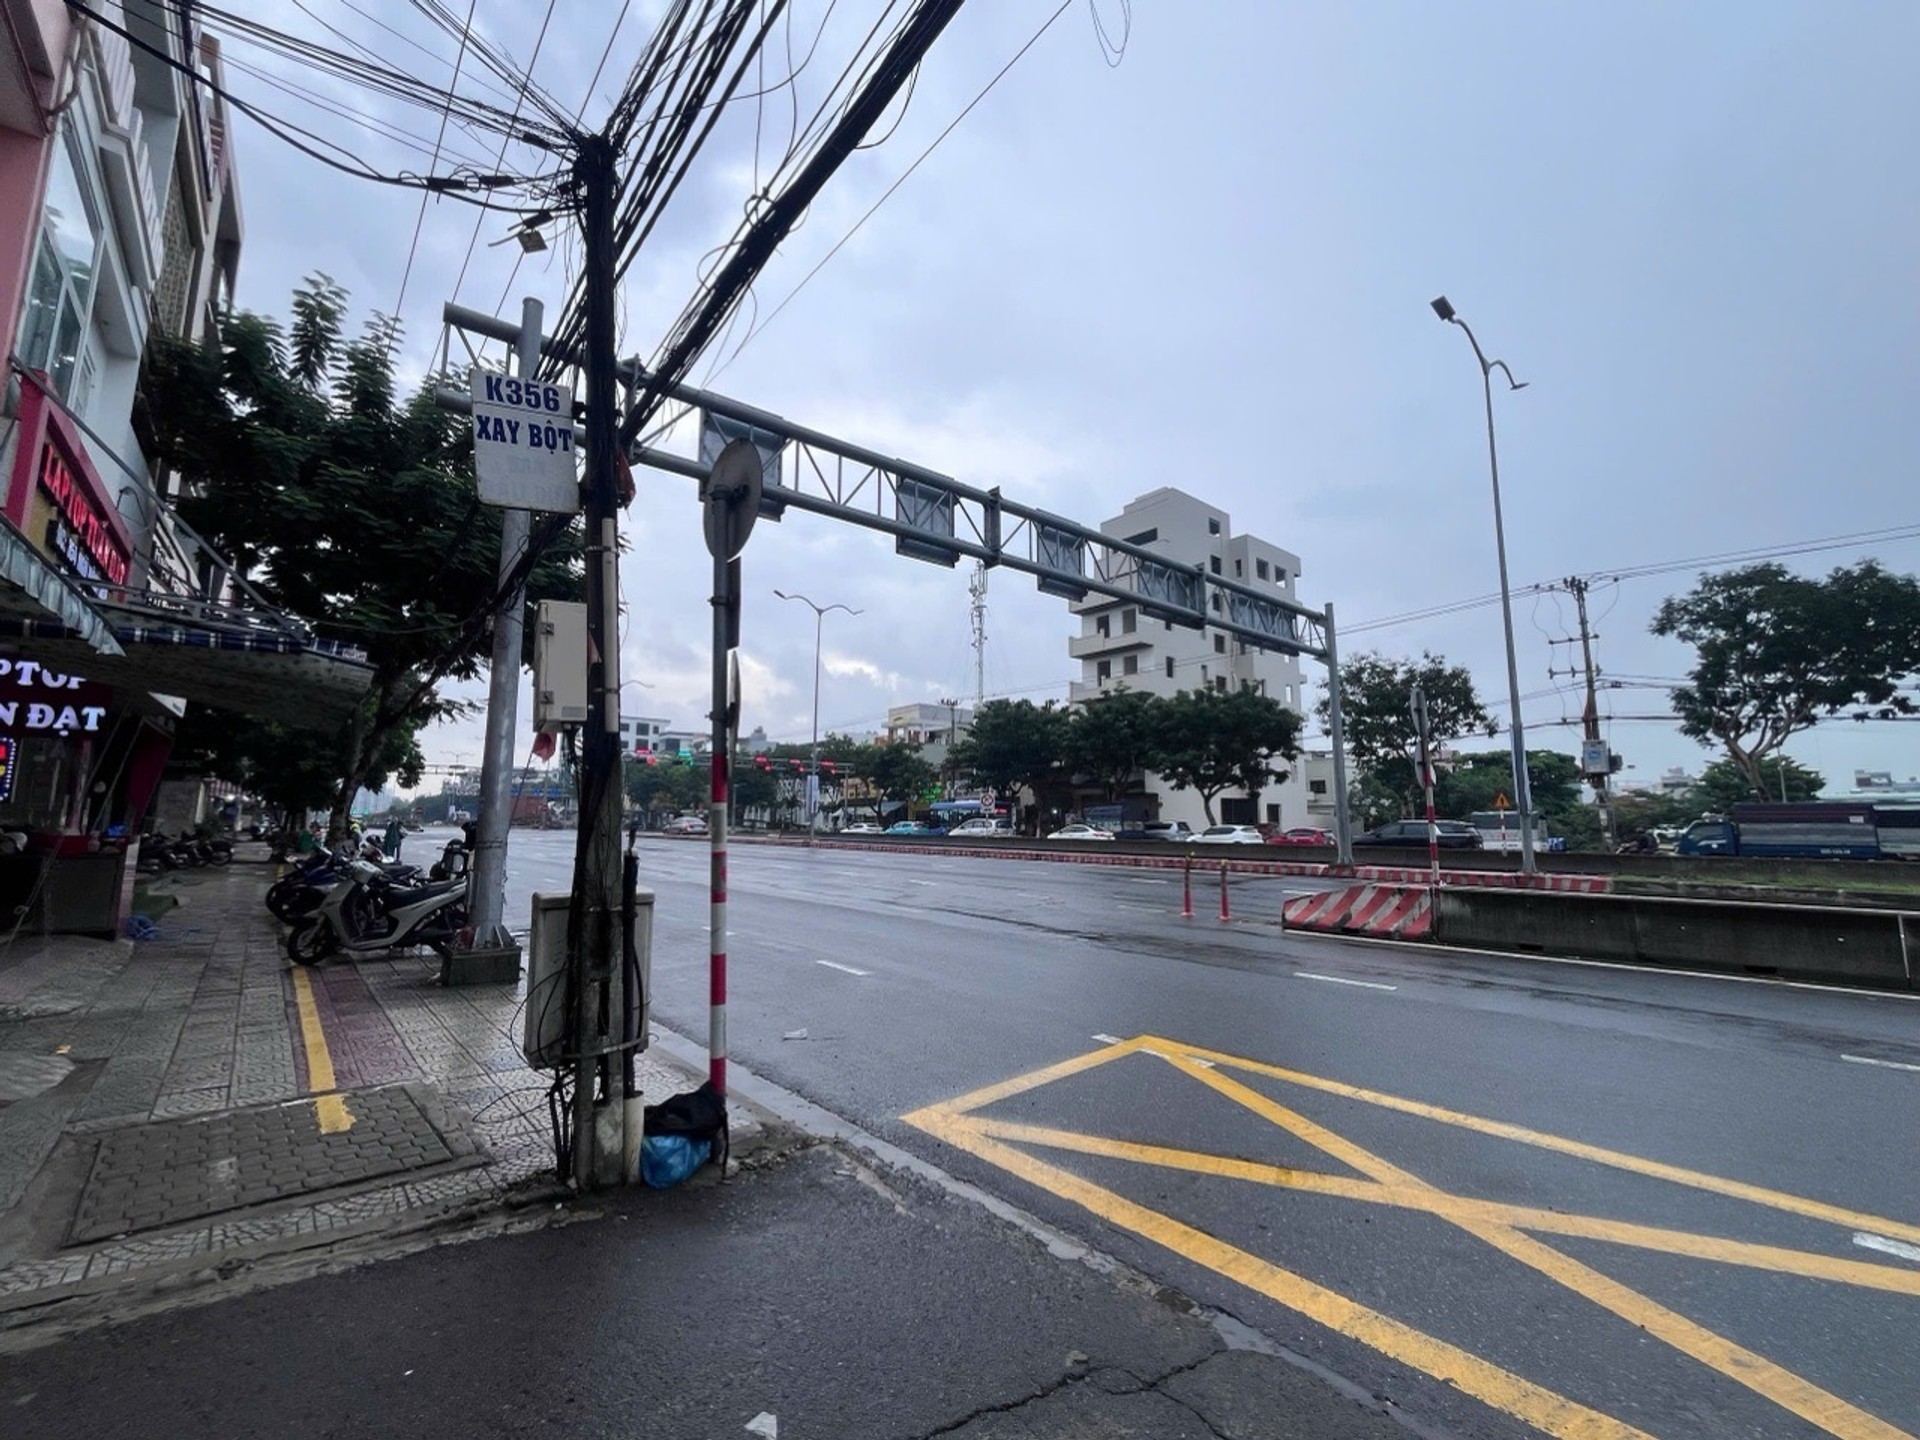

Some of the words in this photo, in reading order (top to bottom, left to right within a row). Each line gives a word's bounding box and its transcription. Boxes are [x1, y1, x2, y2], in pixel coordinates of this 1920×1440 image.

[486, 376, 560, 412] K356
[476, 415, 519, 444] XAY
[529, 420, 572, 454] BỘT
[26, 703, 106, 737] ĐẠT
